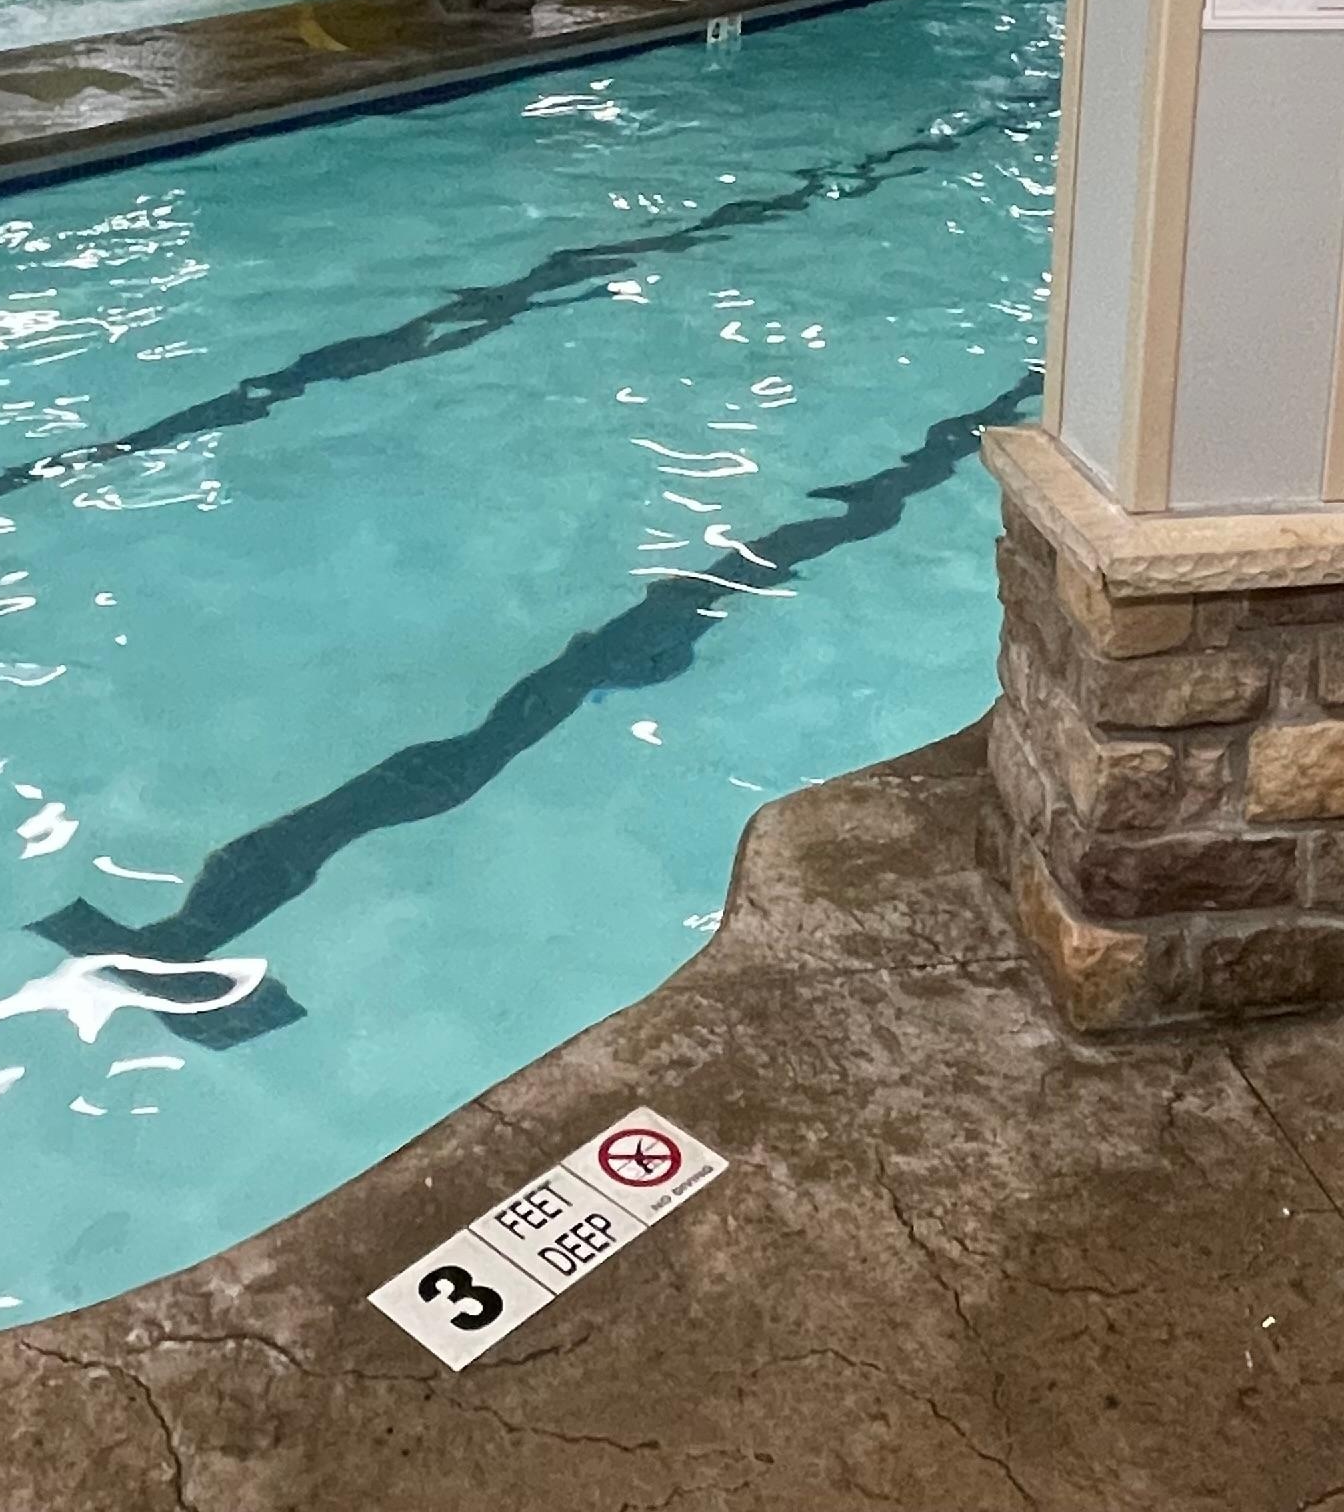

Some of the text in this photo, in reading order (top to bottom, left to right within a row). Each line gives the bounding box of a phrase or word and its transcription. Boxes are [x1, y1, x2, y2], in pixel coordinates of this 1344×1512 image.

[495, 1179, 574, 1240] FEET
[650, 1194, 672, 1211] NO
[672, 1164, 714, 1196] DIVING
[538, 1212, 617, 1277] DEEP
[418, 1265, 504, 1331] 3
